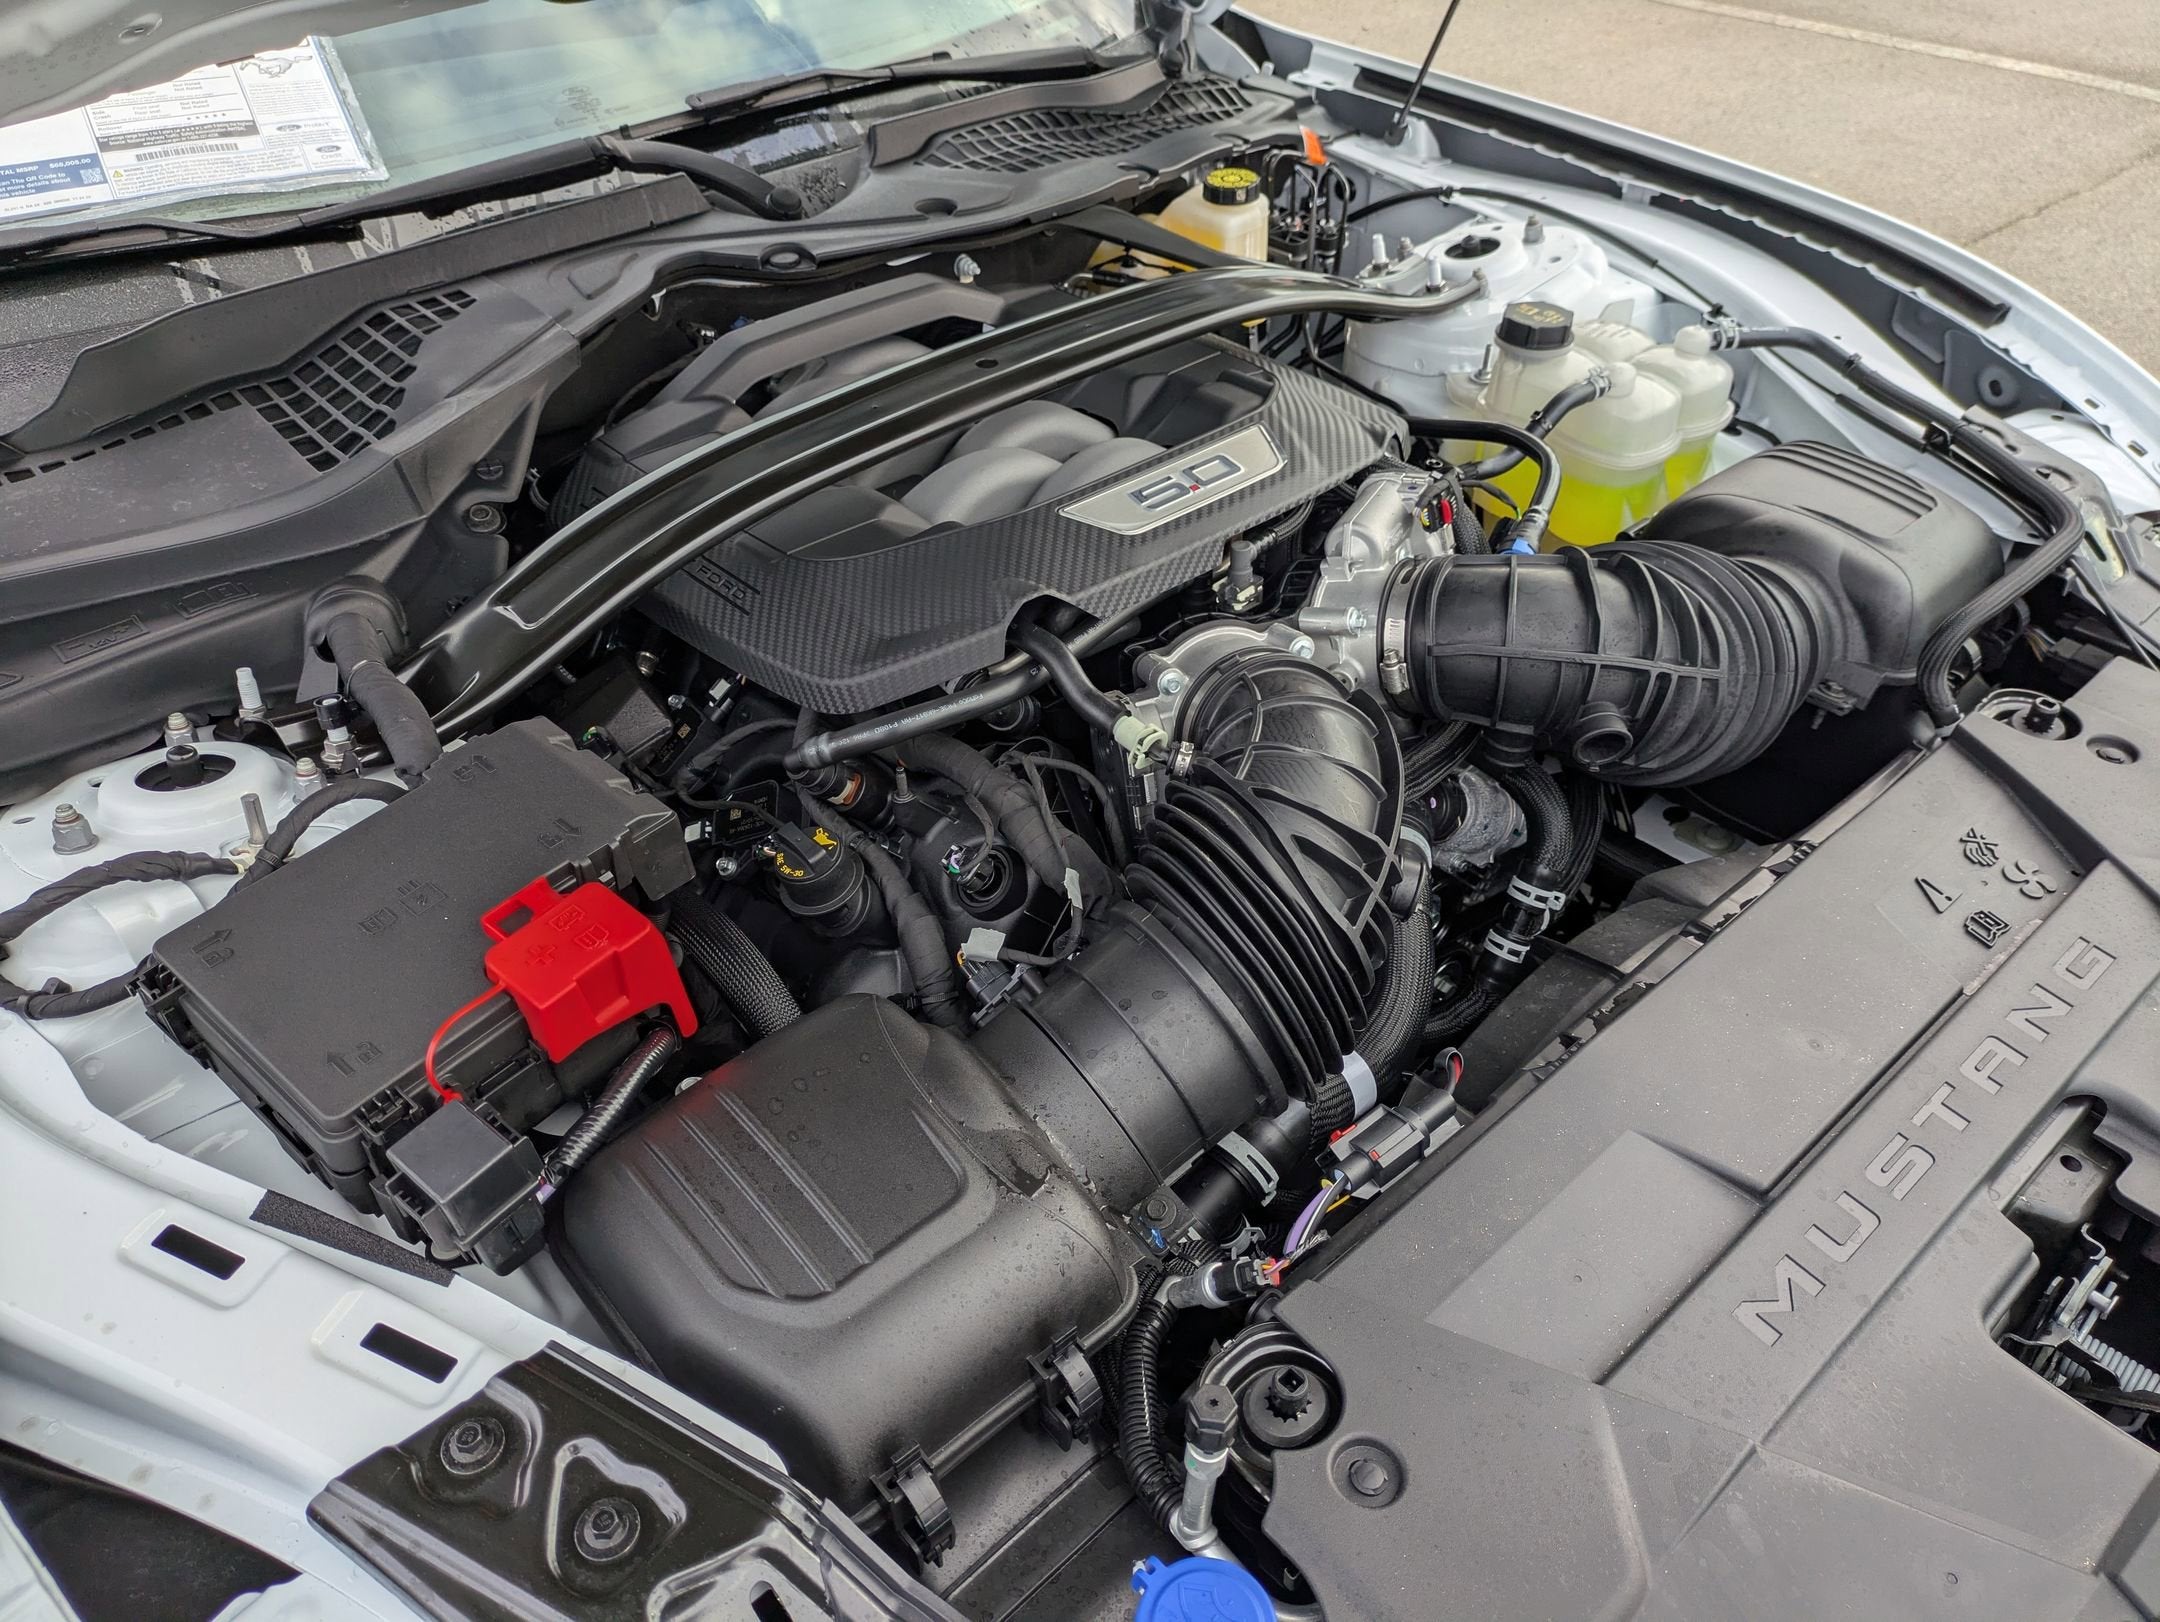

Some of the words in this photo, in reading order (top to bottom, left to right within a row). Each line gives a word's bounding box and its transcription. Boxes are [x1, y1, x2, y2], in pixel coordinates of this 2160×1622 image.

[16, 165, 39, 173] MSRP
[1128, 454, 1245, 513] 5.0
[696, 565, 746, 600] FORD
[781, 864, 804, 877] 5W-30
[1730, 936, 2117, 1348] MUSTANG
